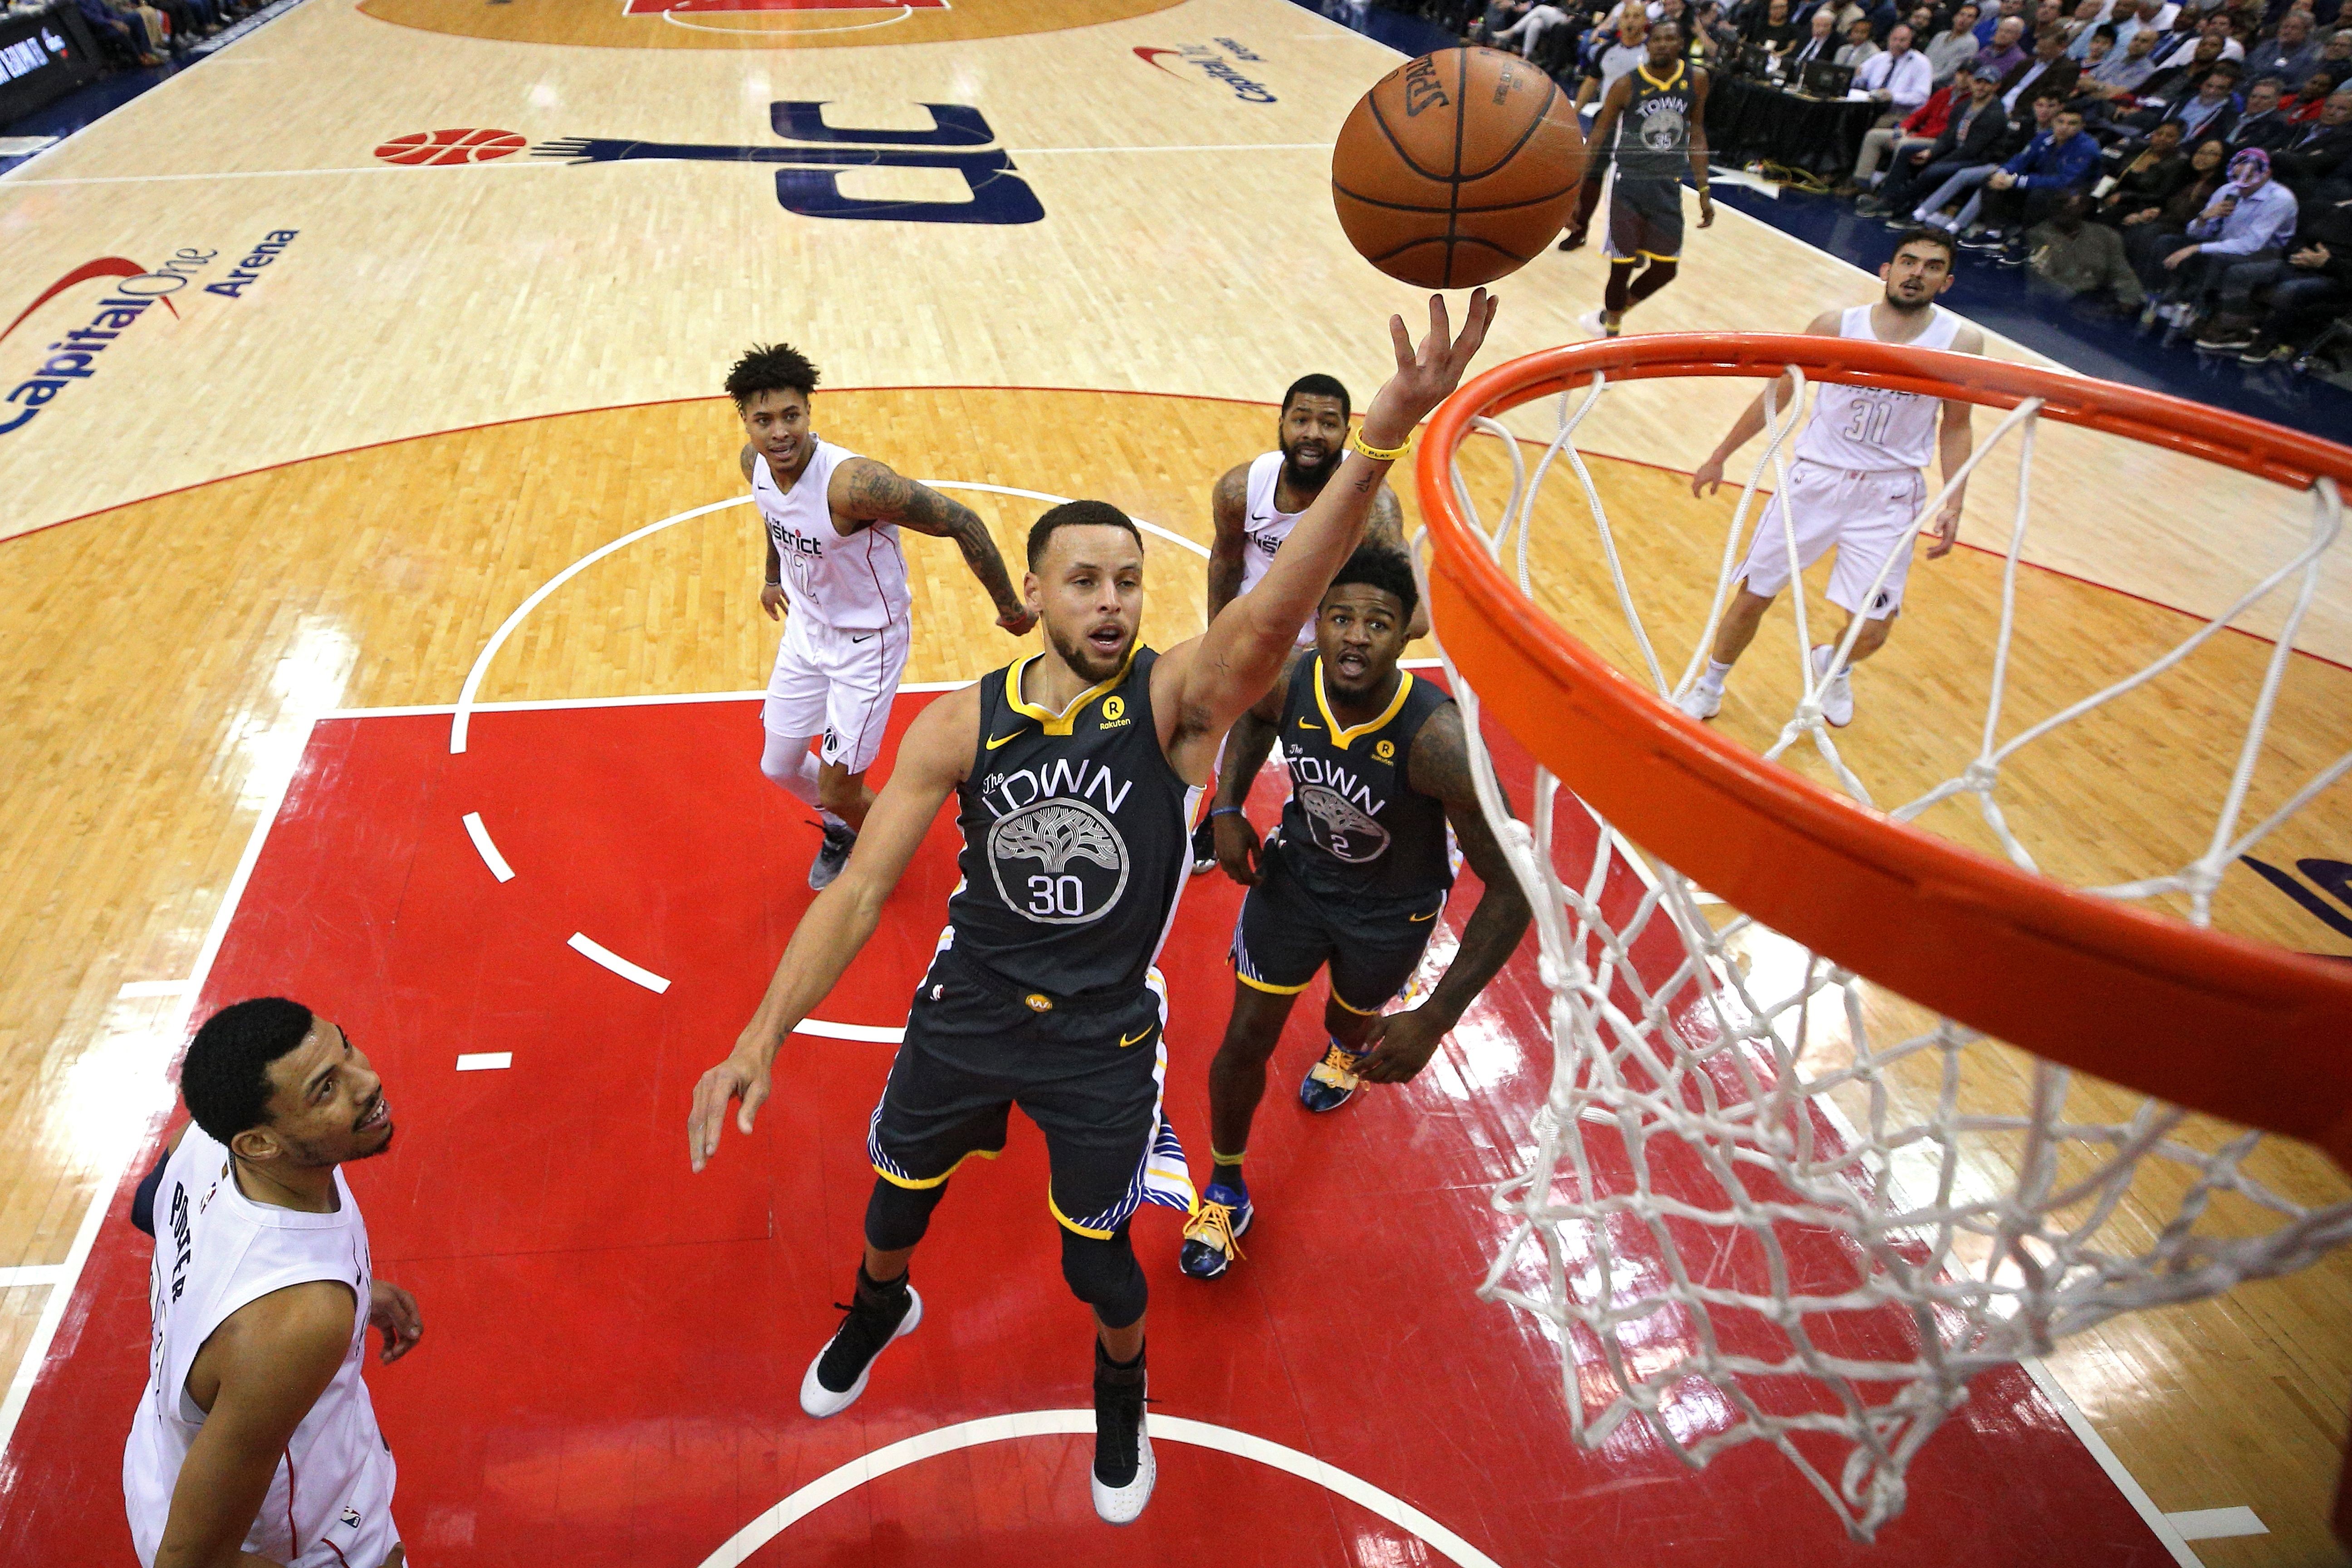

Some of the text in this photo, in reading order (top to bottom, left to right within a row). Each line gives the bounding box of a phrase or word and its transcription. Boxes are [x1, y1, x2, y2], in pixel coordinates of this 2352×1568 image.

[1635, 96, 1688, 118] TOWN
[203, 229, 299, 298] Arena
[1843, 397, 1892, 445] 31
[1099, 718, 1131, 730] Rakuten
[982, 772, 1004, 795] The
[1286, 756, 1386, 816] TOWN
[1330, 834, 1352, 858] 2
[1028, 875, 1084, 916] 30
